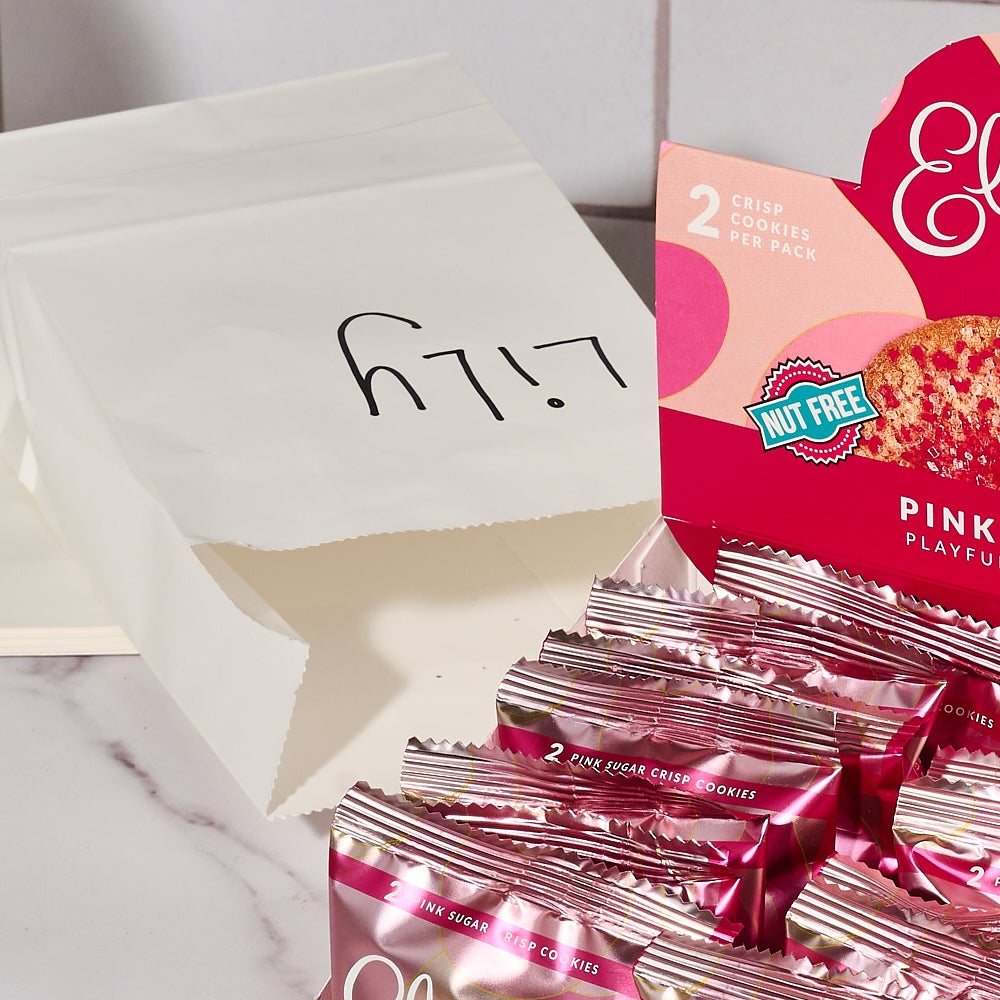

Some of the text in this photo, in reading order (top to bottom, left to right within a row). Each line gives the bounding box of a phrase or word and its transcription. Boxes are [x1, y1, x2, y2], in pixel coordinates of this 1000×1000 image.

[687, 184, 720, 239] 2
[731, 194, 784, 216] CRISP
[729, 230, 817, 261] PER PACK
[730, 212, 811, 242] COOKIES
[760, 385, 866, 439] NUT FREE
[900, 497, 996, 544] PINK
[940, 704, 994, 729] OOKIES
[544, 743, 757, 800] 2 PINK SUGAR CRISP COOKIES
[966, 866, 985, 888] 2
[384, 880, 402, 902] 2
[448, 911, 489, 934] SUGAR
